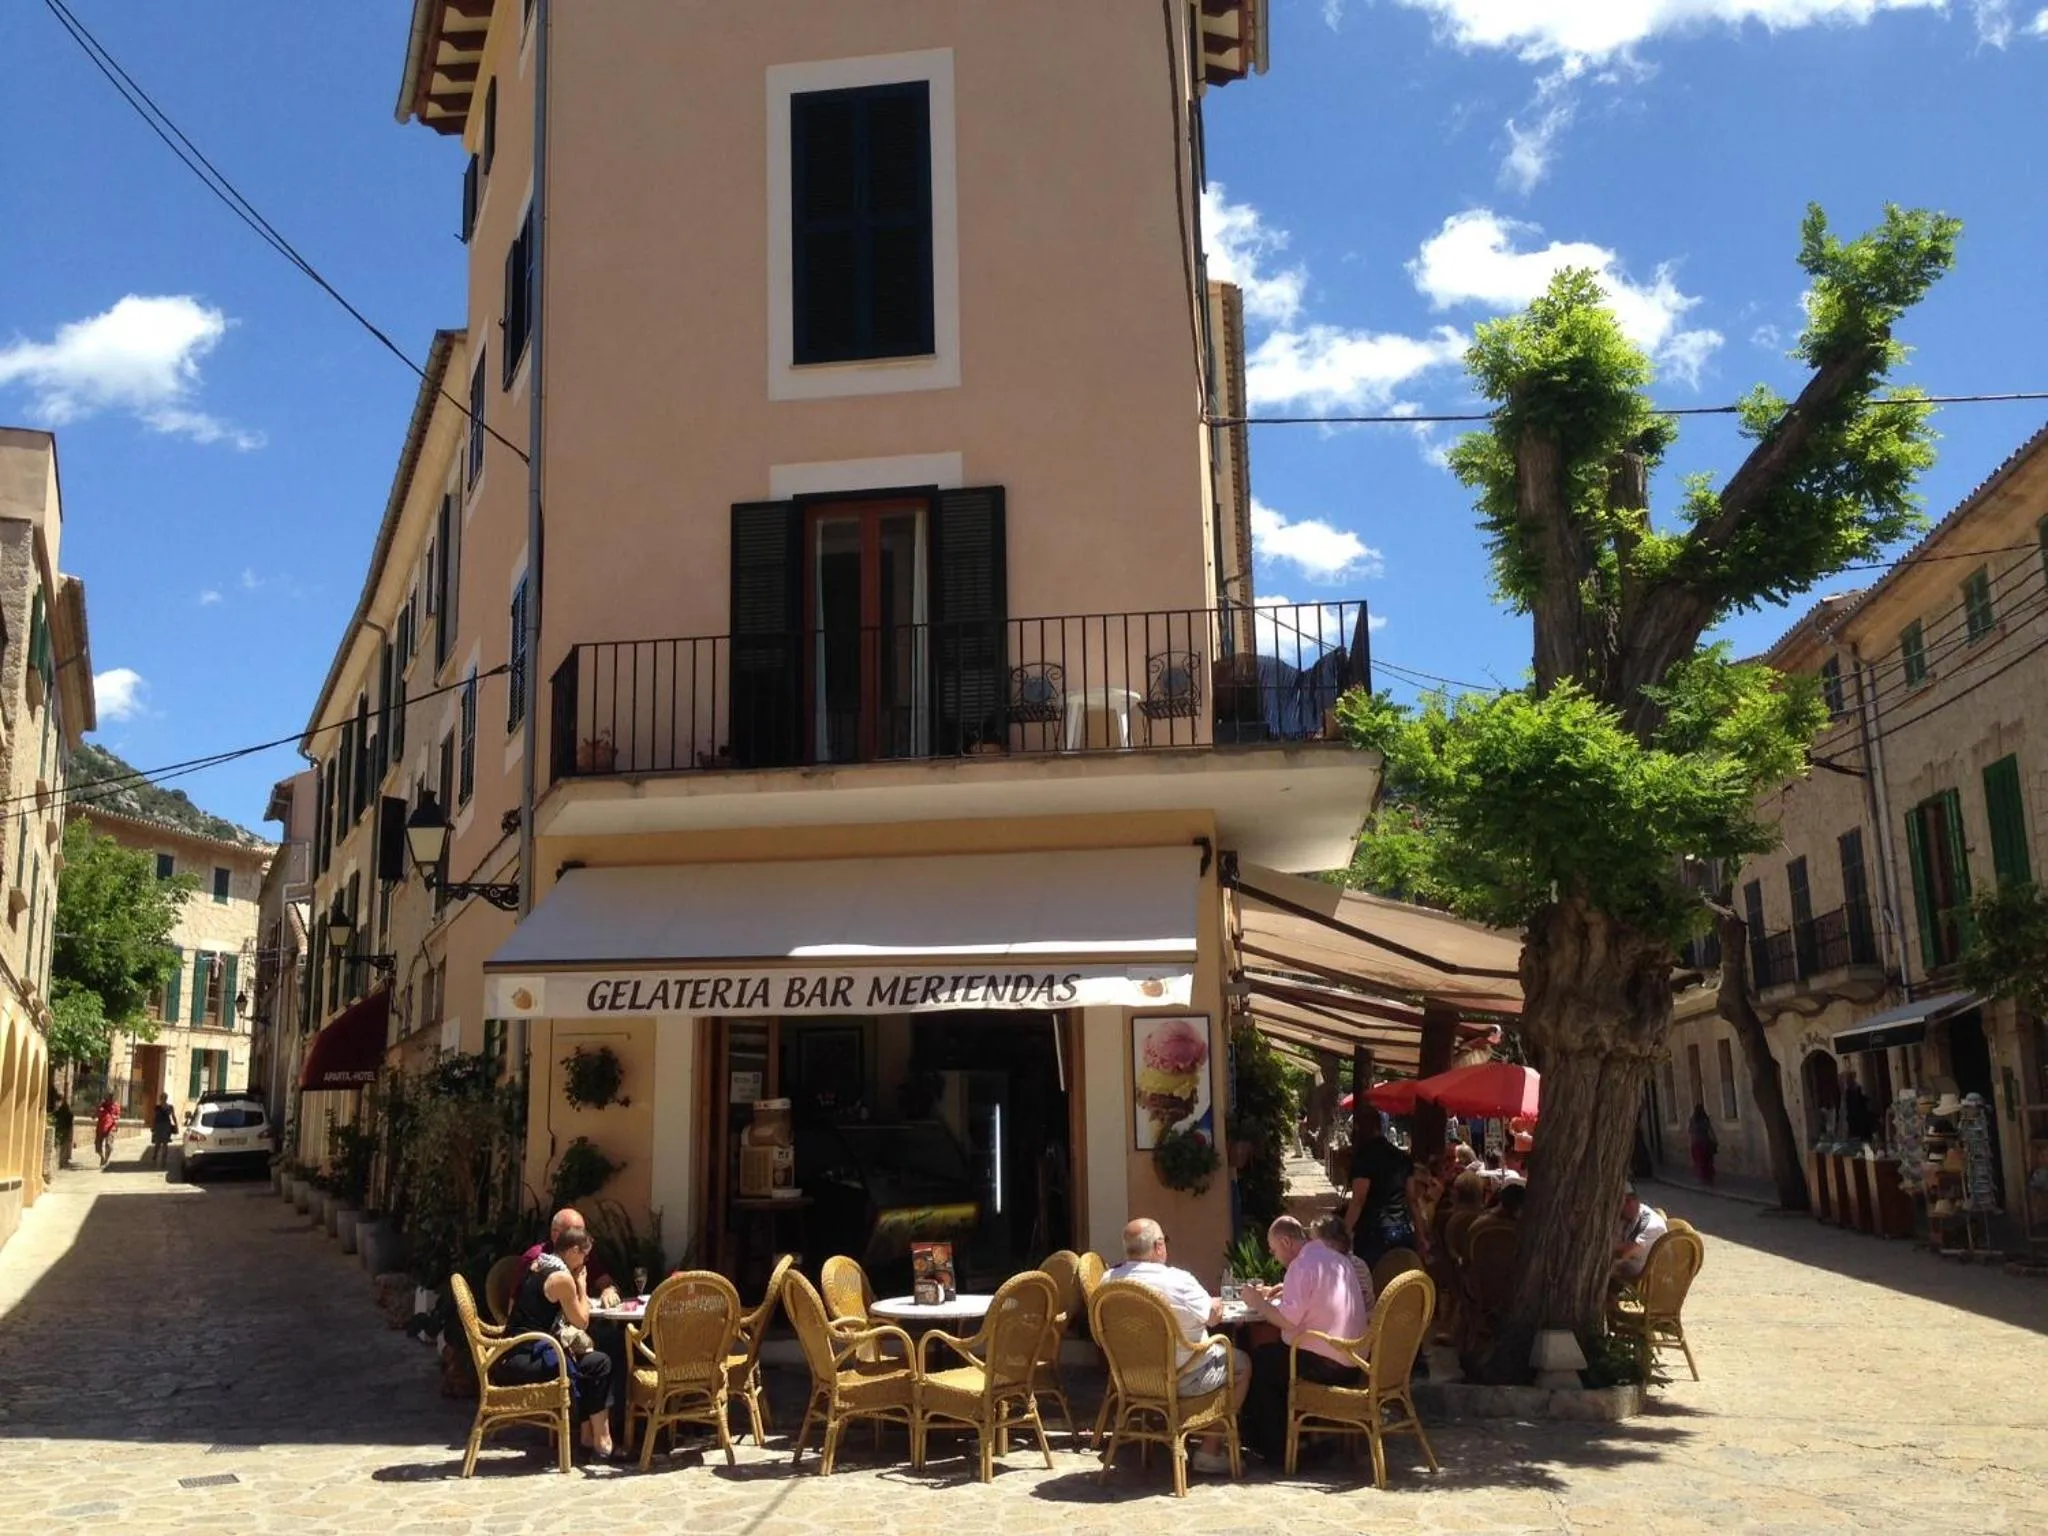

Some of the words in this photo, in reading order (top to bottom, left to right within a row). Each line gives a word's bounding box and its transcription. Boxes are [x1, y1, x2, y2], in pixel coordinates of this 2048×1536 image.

[587, 977, 770, 1010] GELATERIA
[784, 976, 855, 1007] BAR
[867, 973, 1081, 1006] MERIENDAS
